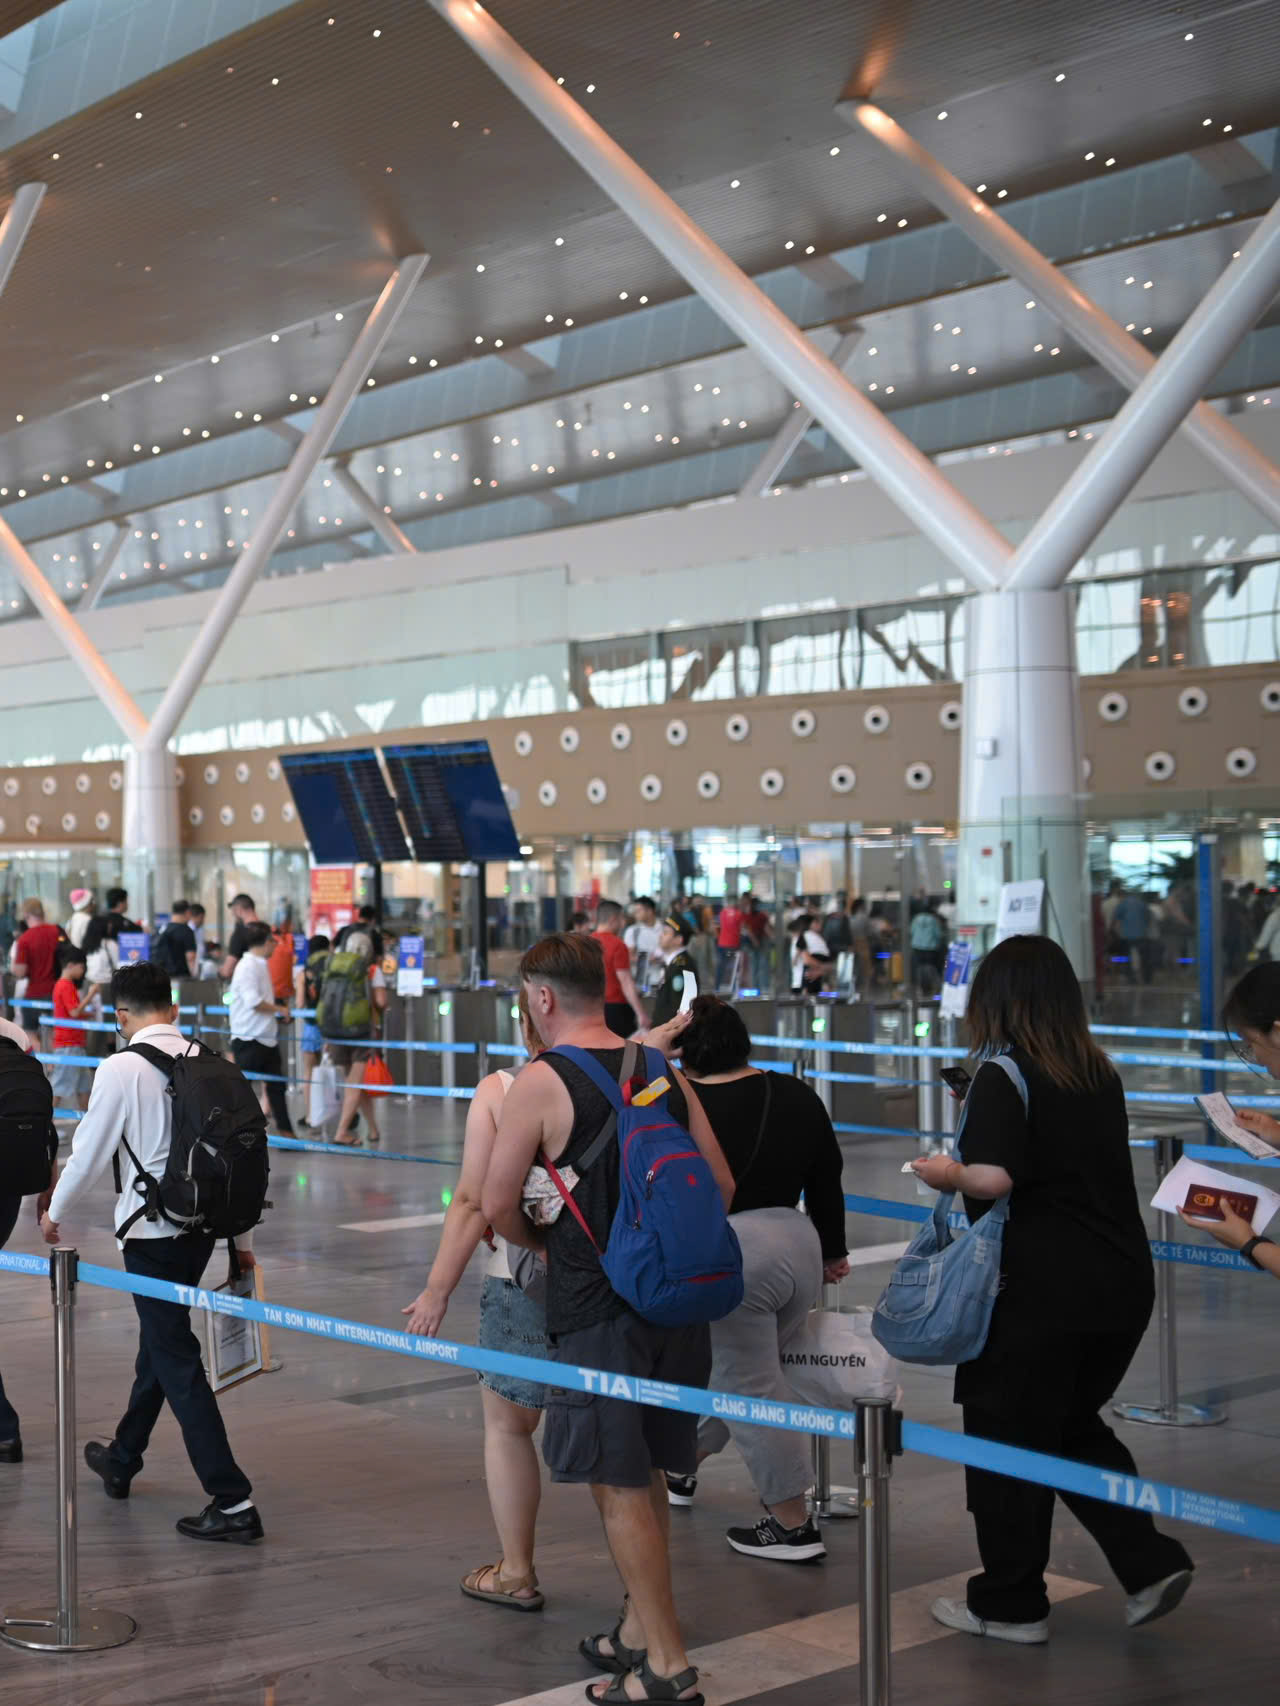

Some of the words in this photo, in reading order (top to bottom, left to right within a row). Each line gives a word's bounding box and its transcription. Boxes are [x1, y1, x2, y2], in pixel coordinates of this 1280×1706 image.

[174, 1285, 212, 1310] TIA
[264, 1307, 282, 1323] TAN
[285, 1310, 304, 1327] SON
[307, 1316, 332, 1333] NHAT
[335, 1322, 412, 1351] INTERNATIONAL
[415, 1338, 459, 1360] AIRPORT
[578, 1367, 632, 1399] TIA
[712, 1393, 746, 1417] CẢNG
[751, 1400, 785, 1424] HÀNG
[790, 1407, 835, 1432] KHÔNG
[1101, 1472, 1161, 1512] TIA
[1182, 1502, 1245, 1524] INTERNATIONAL
